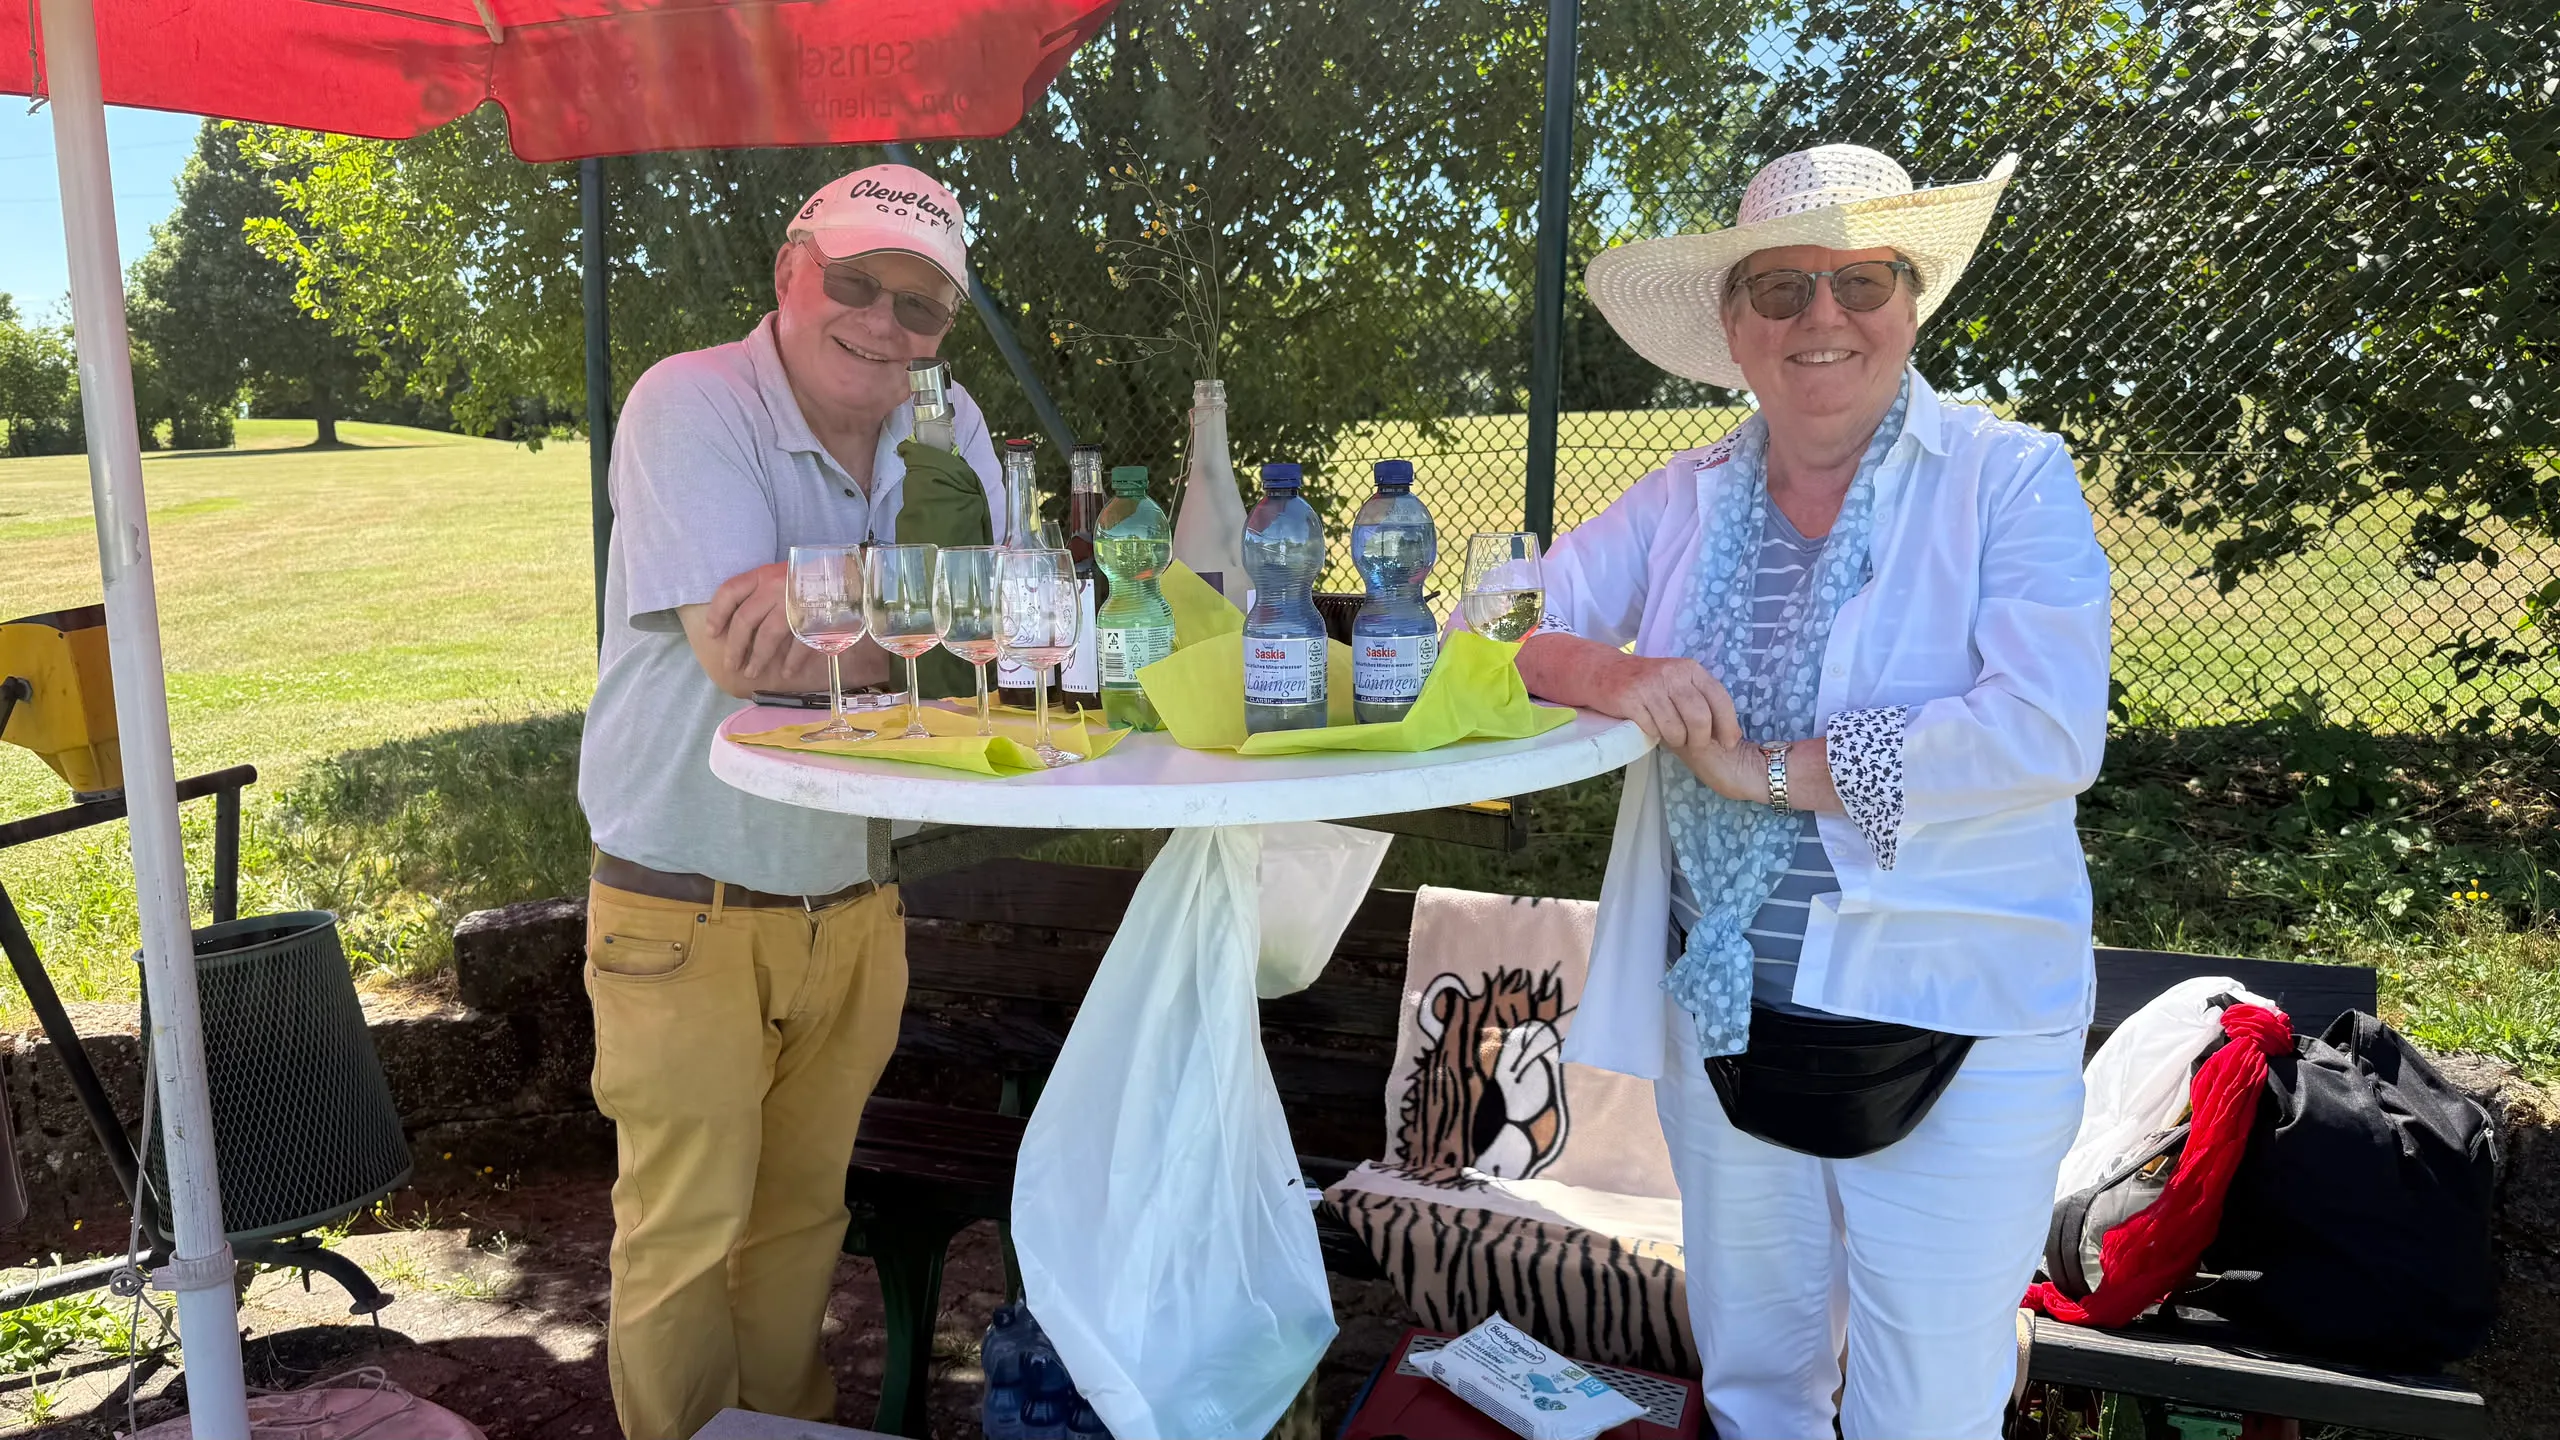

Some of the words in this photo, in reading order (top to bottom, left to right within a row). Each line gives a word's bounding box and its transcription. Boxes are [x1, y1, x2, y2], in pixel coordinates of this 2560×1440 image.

[876, 204, 941, 227] GOLF
[1255, 648, 1286, 659] Saskia
[1366, 647, 1397, 658] Saskia
[1247, 672, 1306, 697] Löningen
[1357, 671, 1417, 696] Löningen
[1360, 695, 1386, 703] CLASSIC
[1490, 1325, 1537, 1360] Babydream
[1584, 1378, 1604, 1392] 60
